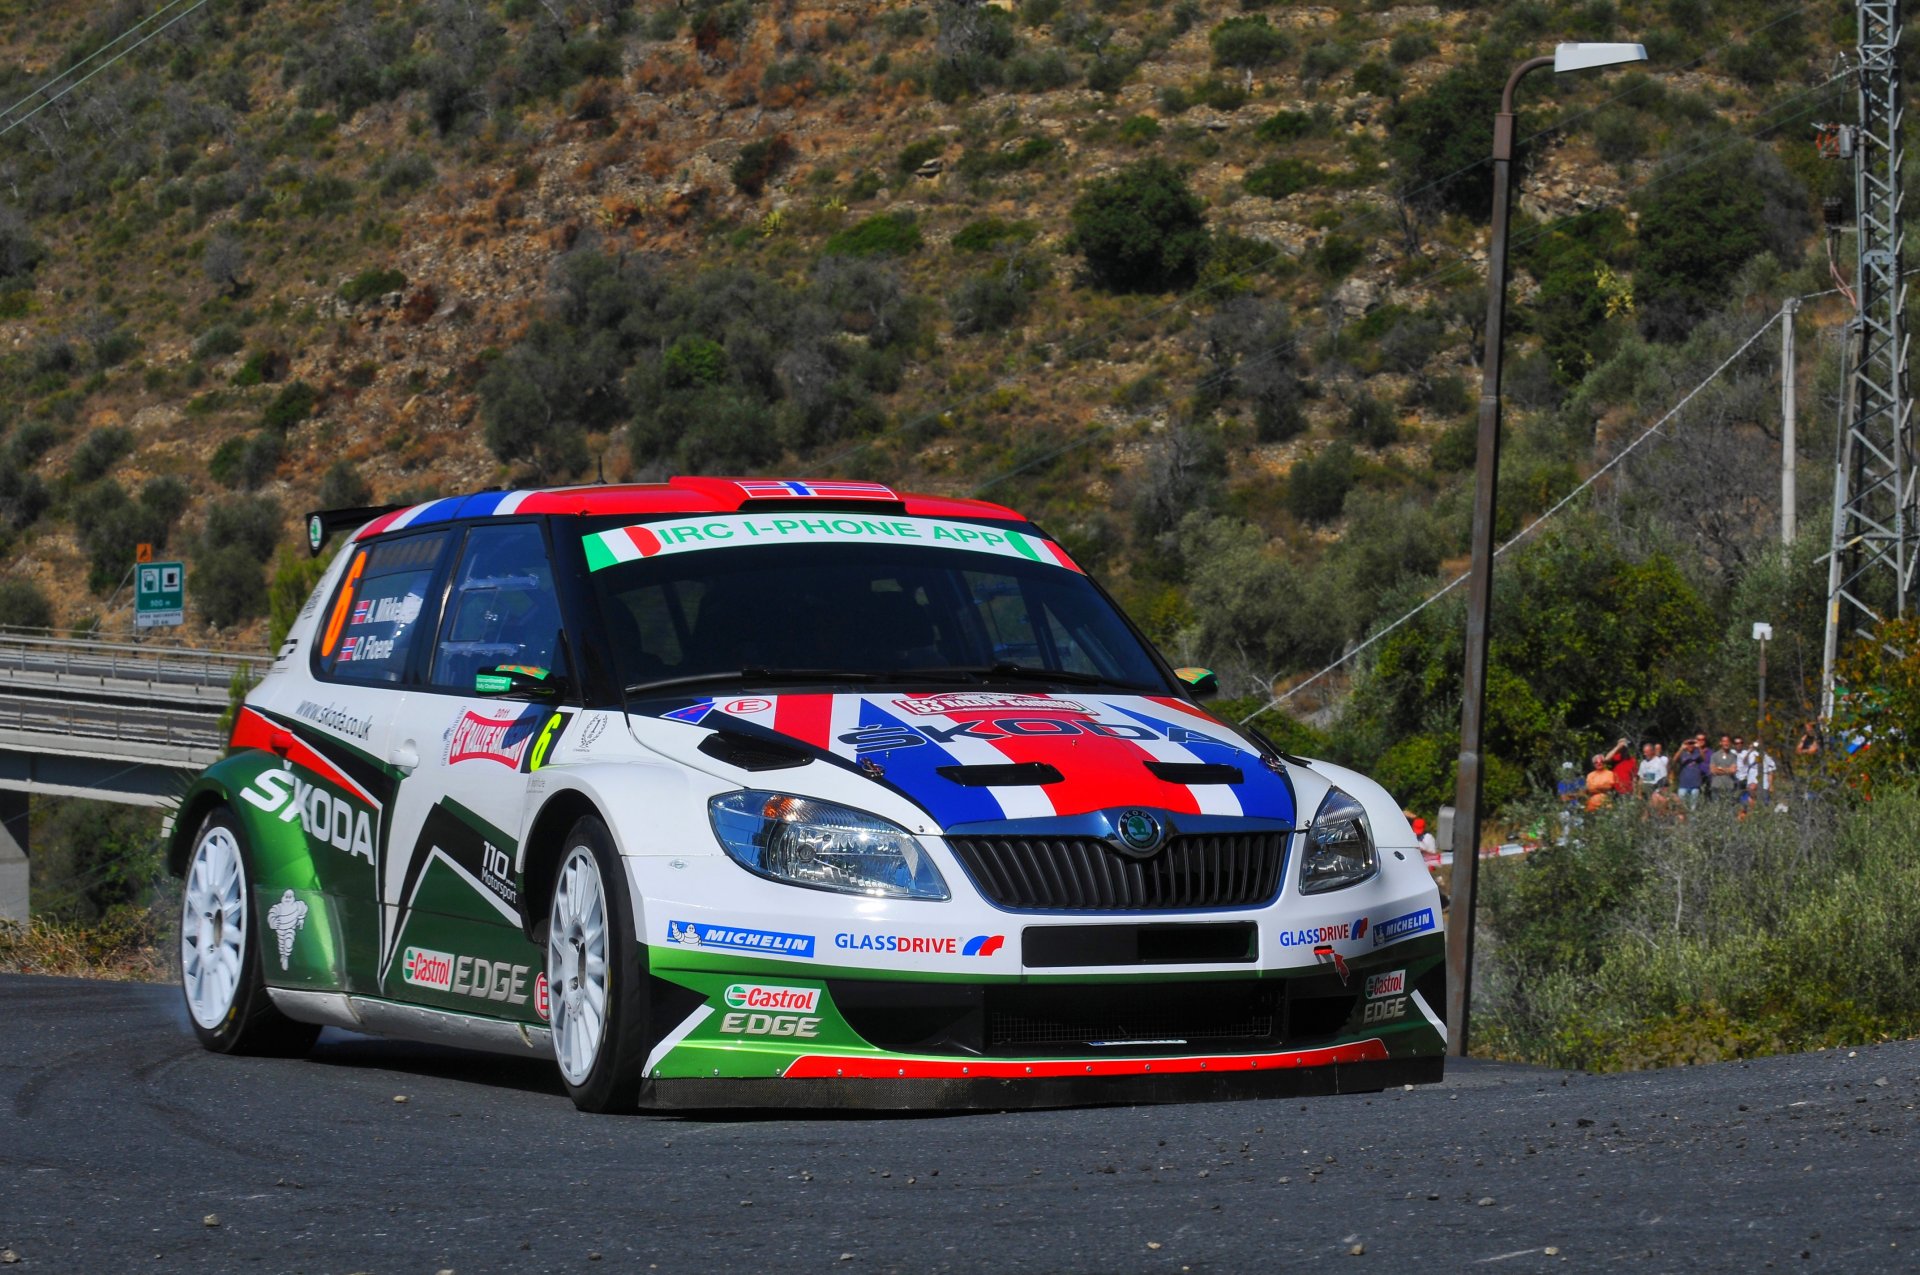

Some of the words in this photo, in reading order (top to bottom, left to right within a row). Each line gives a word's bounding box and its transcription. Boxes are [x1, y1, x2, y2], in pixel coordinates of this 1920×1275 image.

[658, 523, 734, 544] IRC
[743, 519, 922, 538] I-PHONE
[934, 526, 1004, 546] APP
[295, 700, 373, 741] www.skoda.co.uk
[530, 713, 562, 773] 6
[482, 840, 510, 880] 110
[481, 867, 517, 904] Motorsport
[1279, 924, 1349, 947] GLASSDRIVE
[1386, 912, 1430, 936] MICHELIN
[703, 928, 809, 951] MICHELIN
[834, 933, 957, 954] GLASSDRIVE
[414, 952, 450, 986] Castrol
[451, 955, 531, 1005] EDGE
[1373, 973, 1403, 995] Castrol
[747, 987, 815, 1010] Castrol
[1363, 996, 1409, 1024] EDGE
[719, 1013, 823, 1038] EDGE
